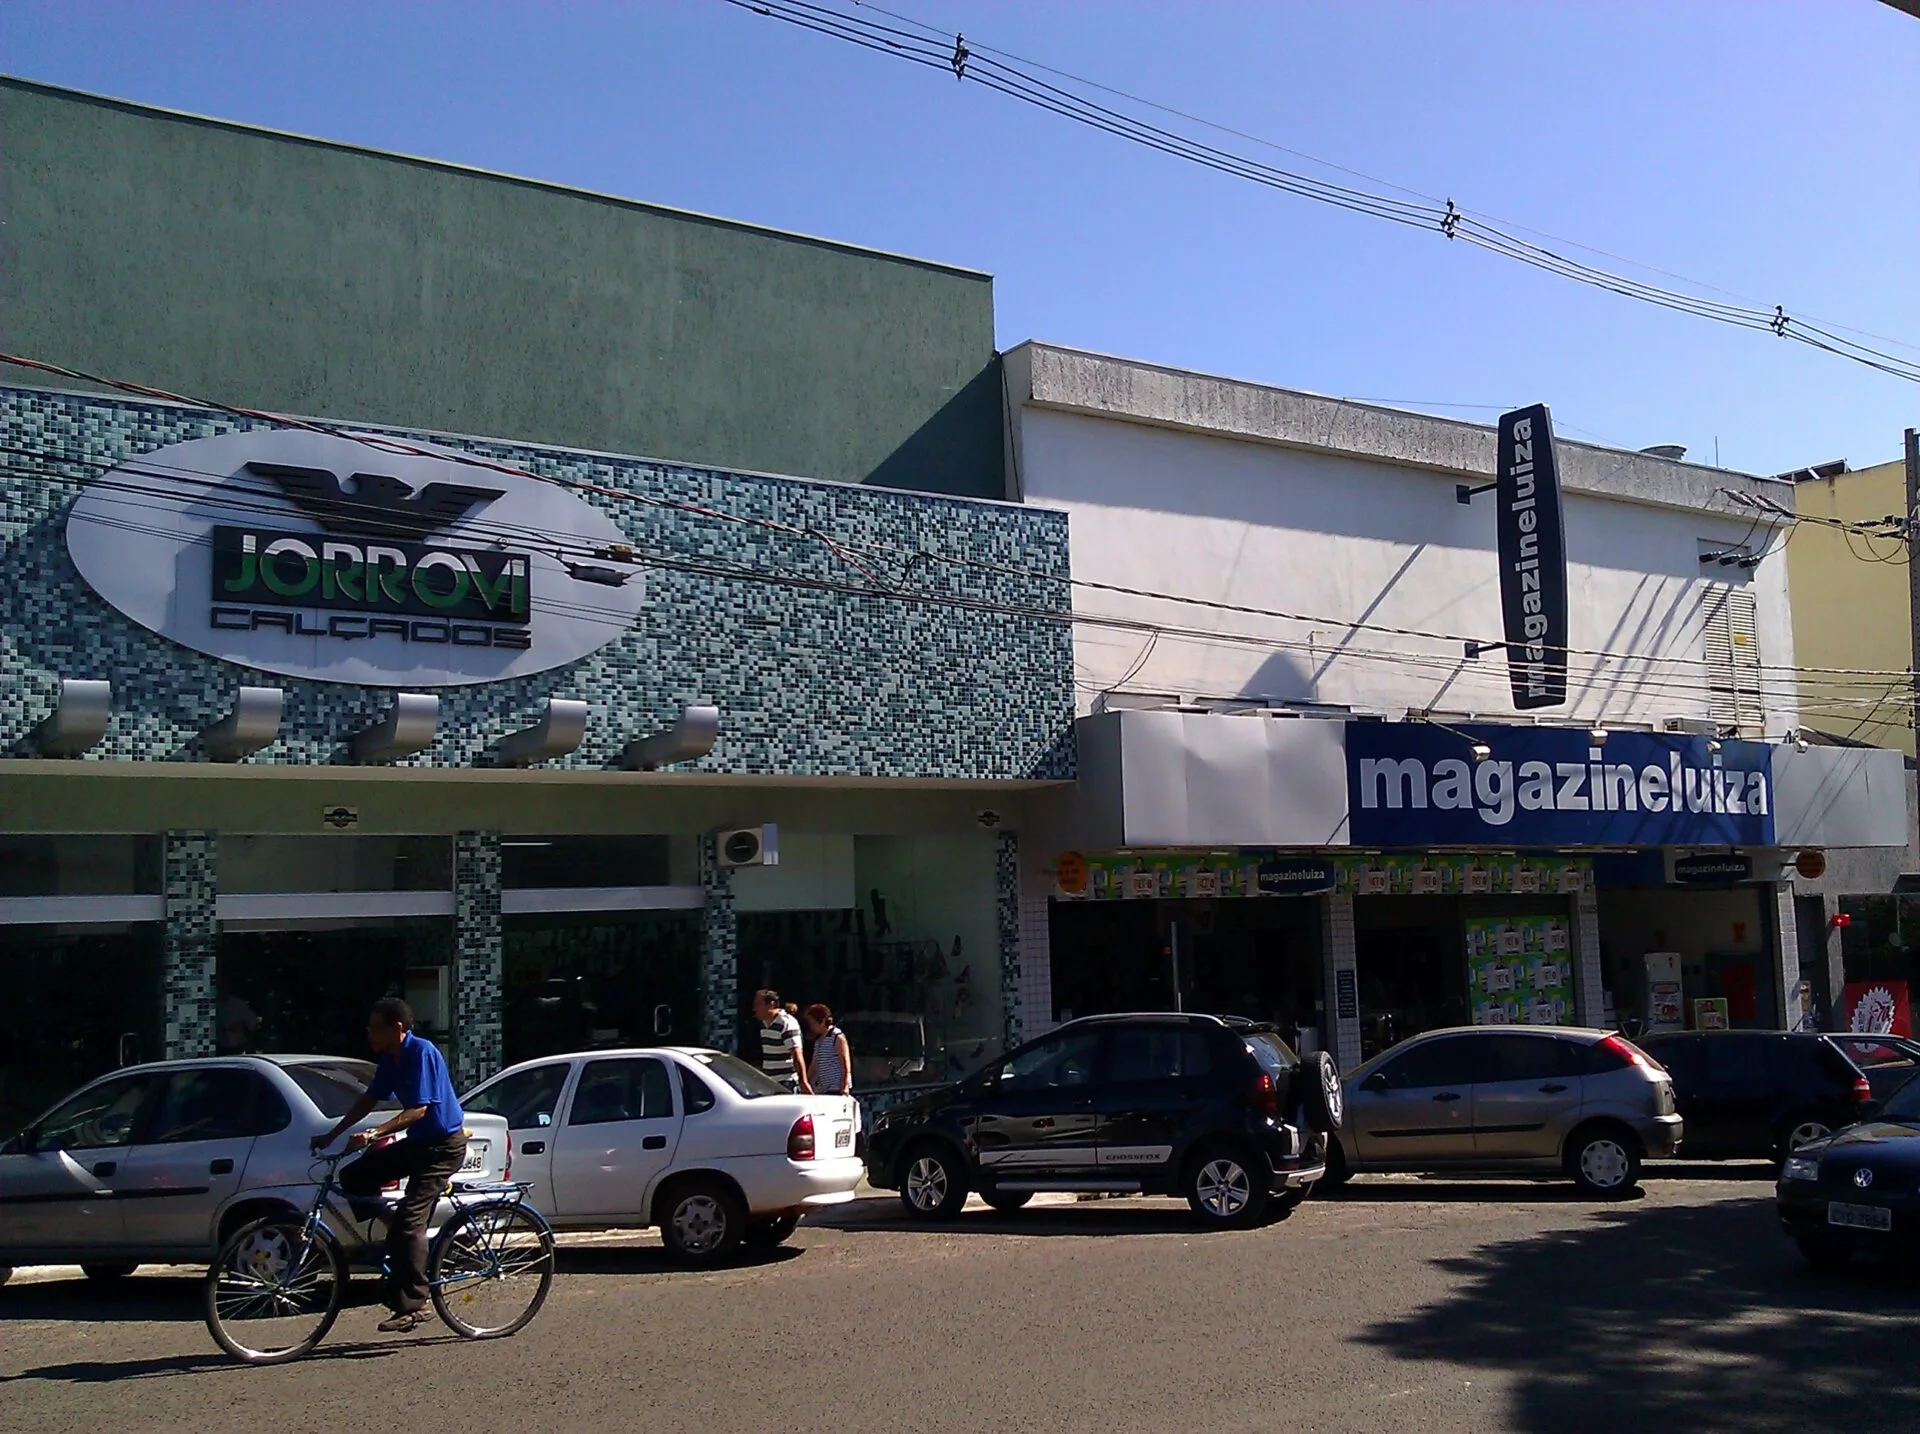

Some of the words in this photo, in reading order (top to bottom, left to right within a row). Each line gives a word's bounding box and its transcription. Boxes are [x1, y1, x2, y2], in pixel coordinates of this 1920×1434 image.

[224, 534, 526, 614] JORROVI
[1511, 416, 1548, 699] magazineluiza
[210, 606, 532, 650] CALÇADOS
[1359, 747, 1769, 826] magazineluiza
[1260, 869, 1325, 884] magazineluiza
